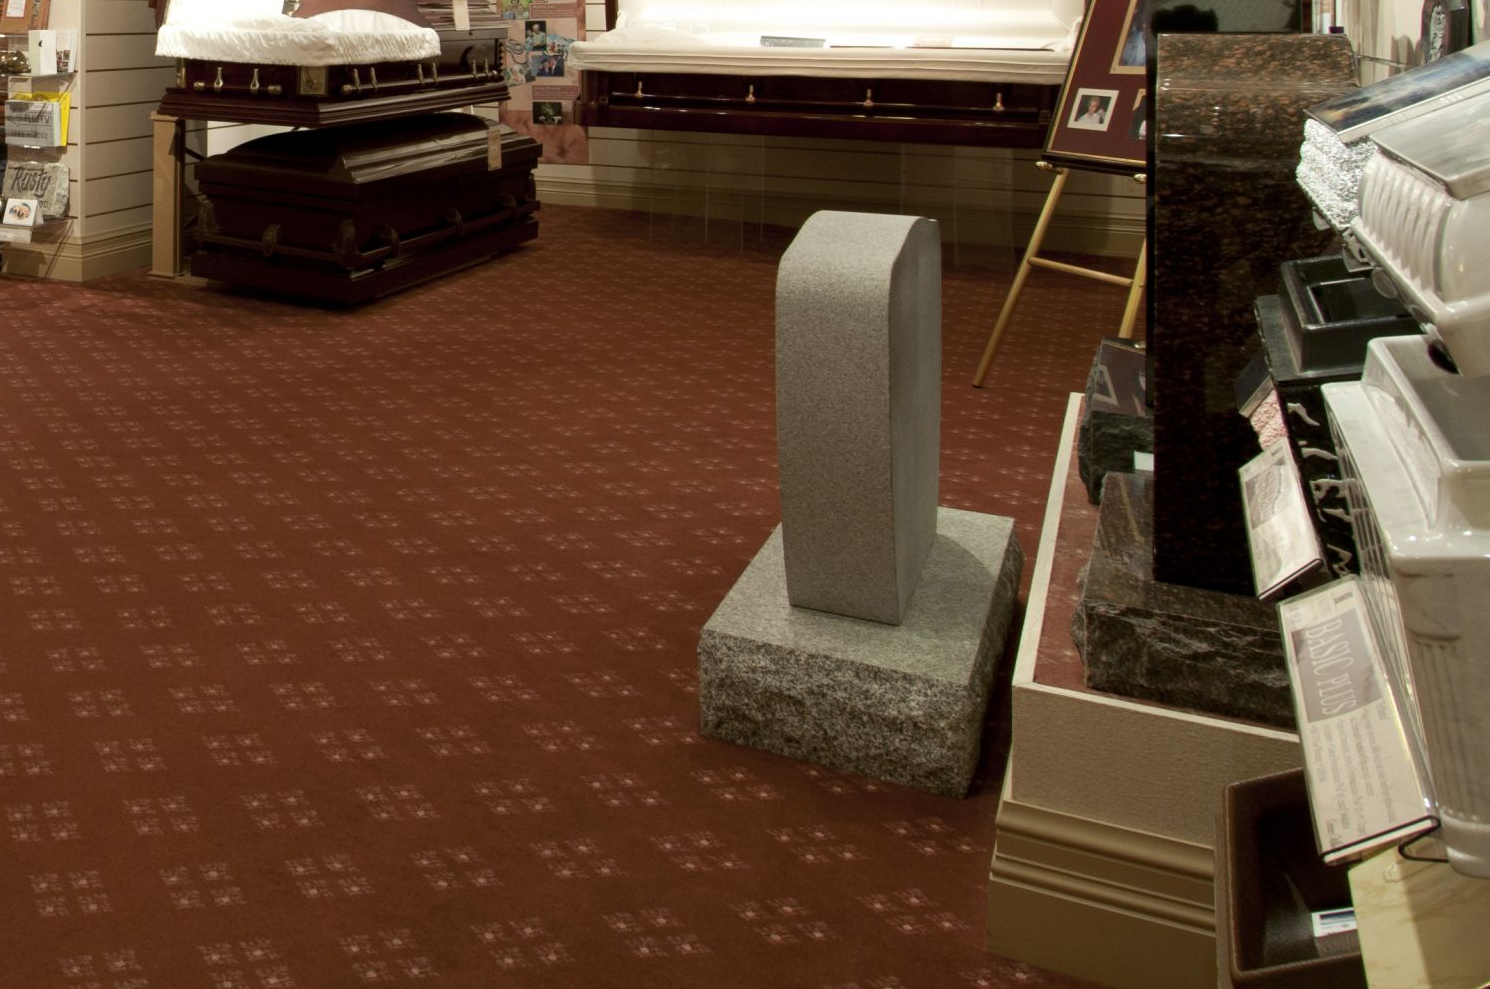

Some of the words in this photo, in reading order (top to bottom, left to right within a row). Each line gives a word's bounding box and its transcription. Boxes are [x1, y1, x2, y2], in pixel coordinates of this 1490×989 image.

[11, 167, 51, 198] Rusty
[1306, 617, 1354, 676] BASIC
[1316, 672, 1358, 716] PLUS
